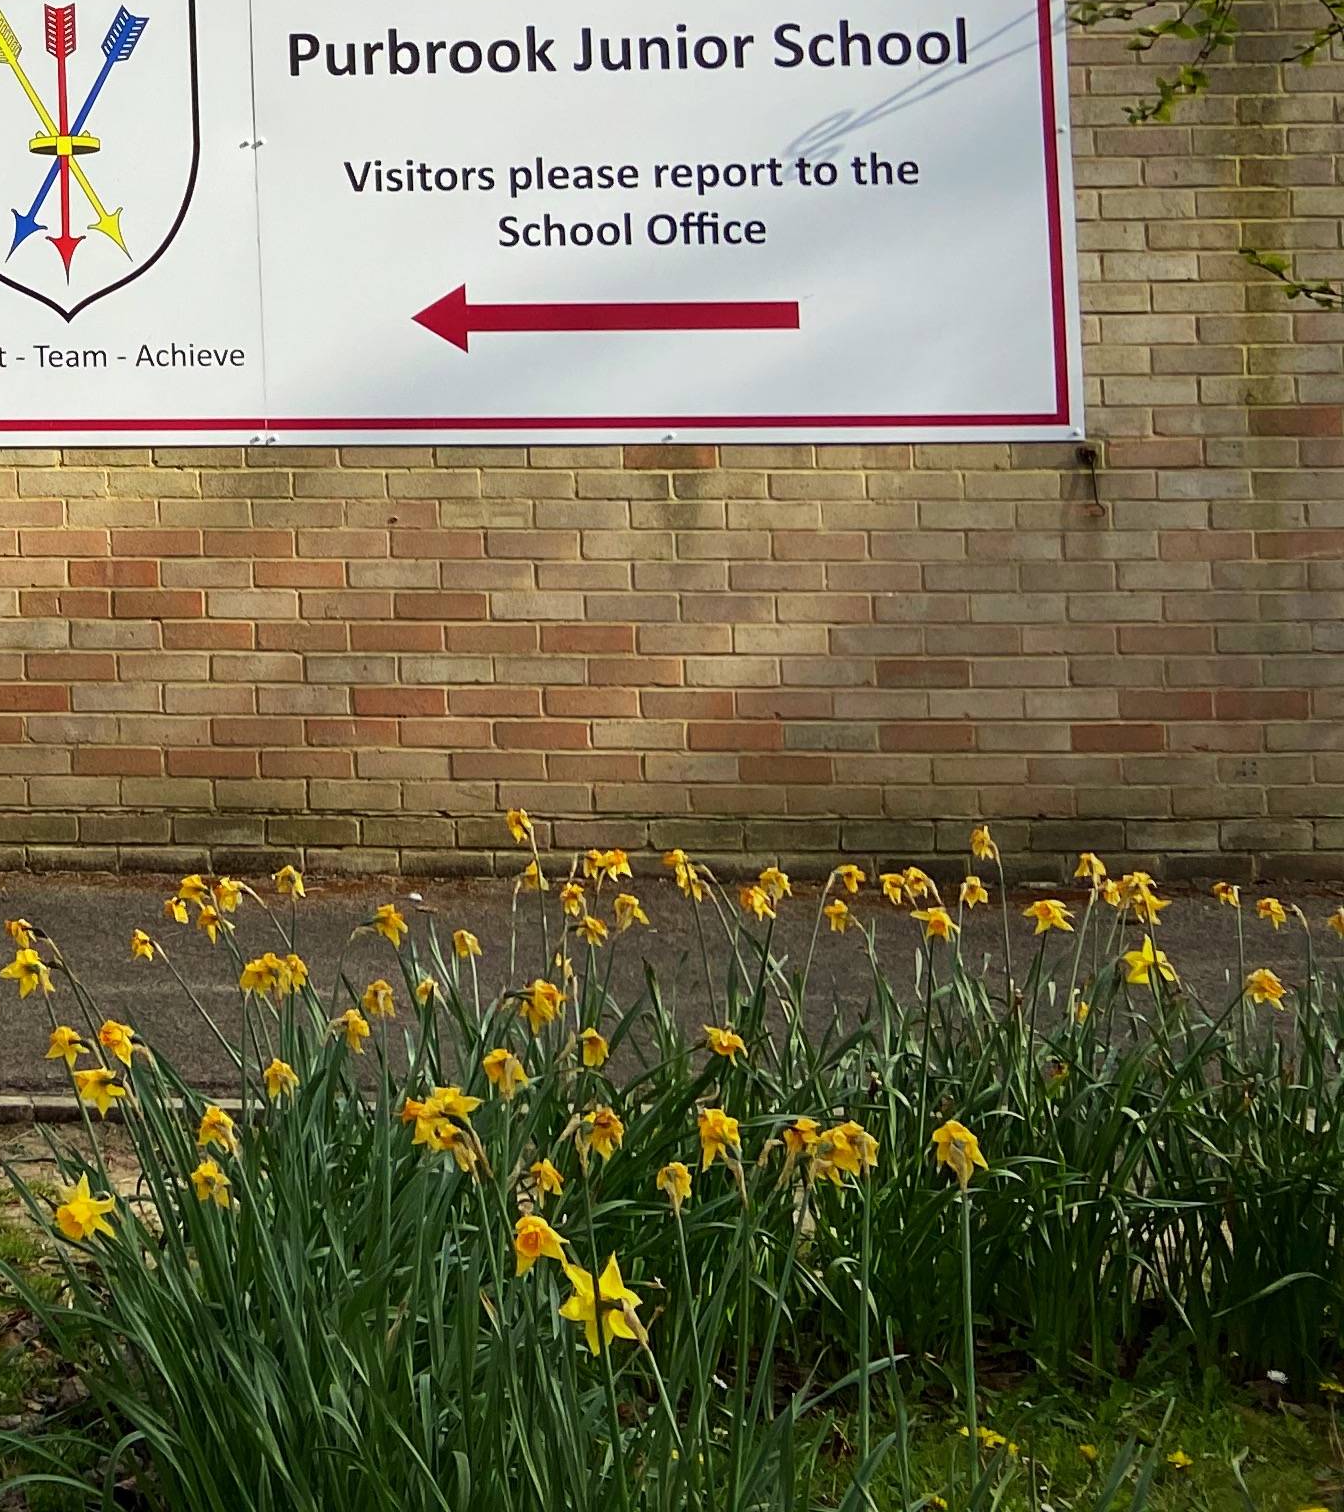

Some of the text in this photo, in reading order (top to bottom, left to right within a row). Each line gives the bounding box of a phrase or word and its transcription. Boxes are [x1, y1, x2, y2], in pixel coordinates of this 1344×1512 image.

[288, 17, 968, 77] Purbrook Junior School
[343, 151, 920, 199] Visitors please report to the
[498, 211, 766, 247] School Office
[32, 344, 107, 368] Team
[135, 342, 246, 367] Achieve
